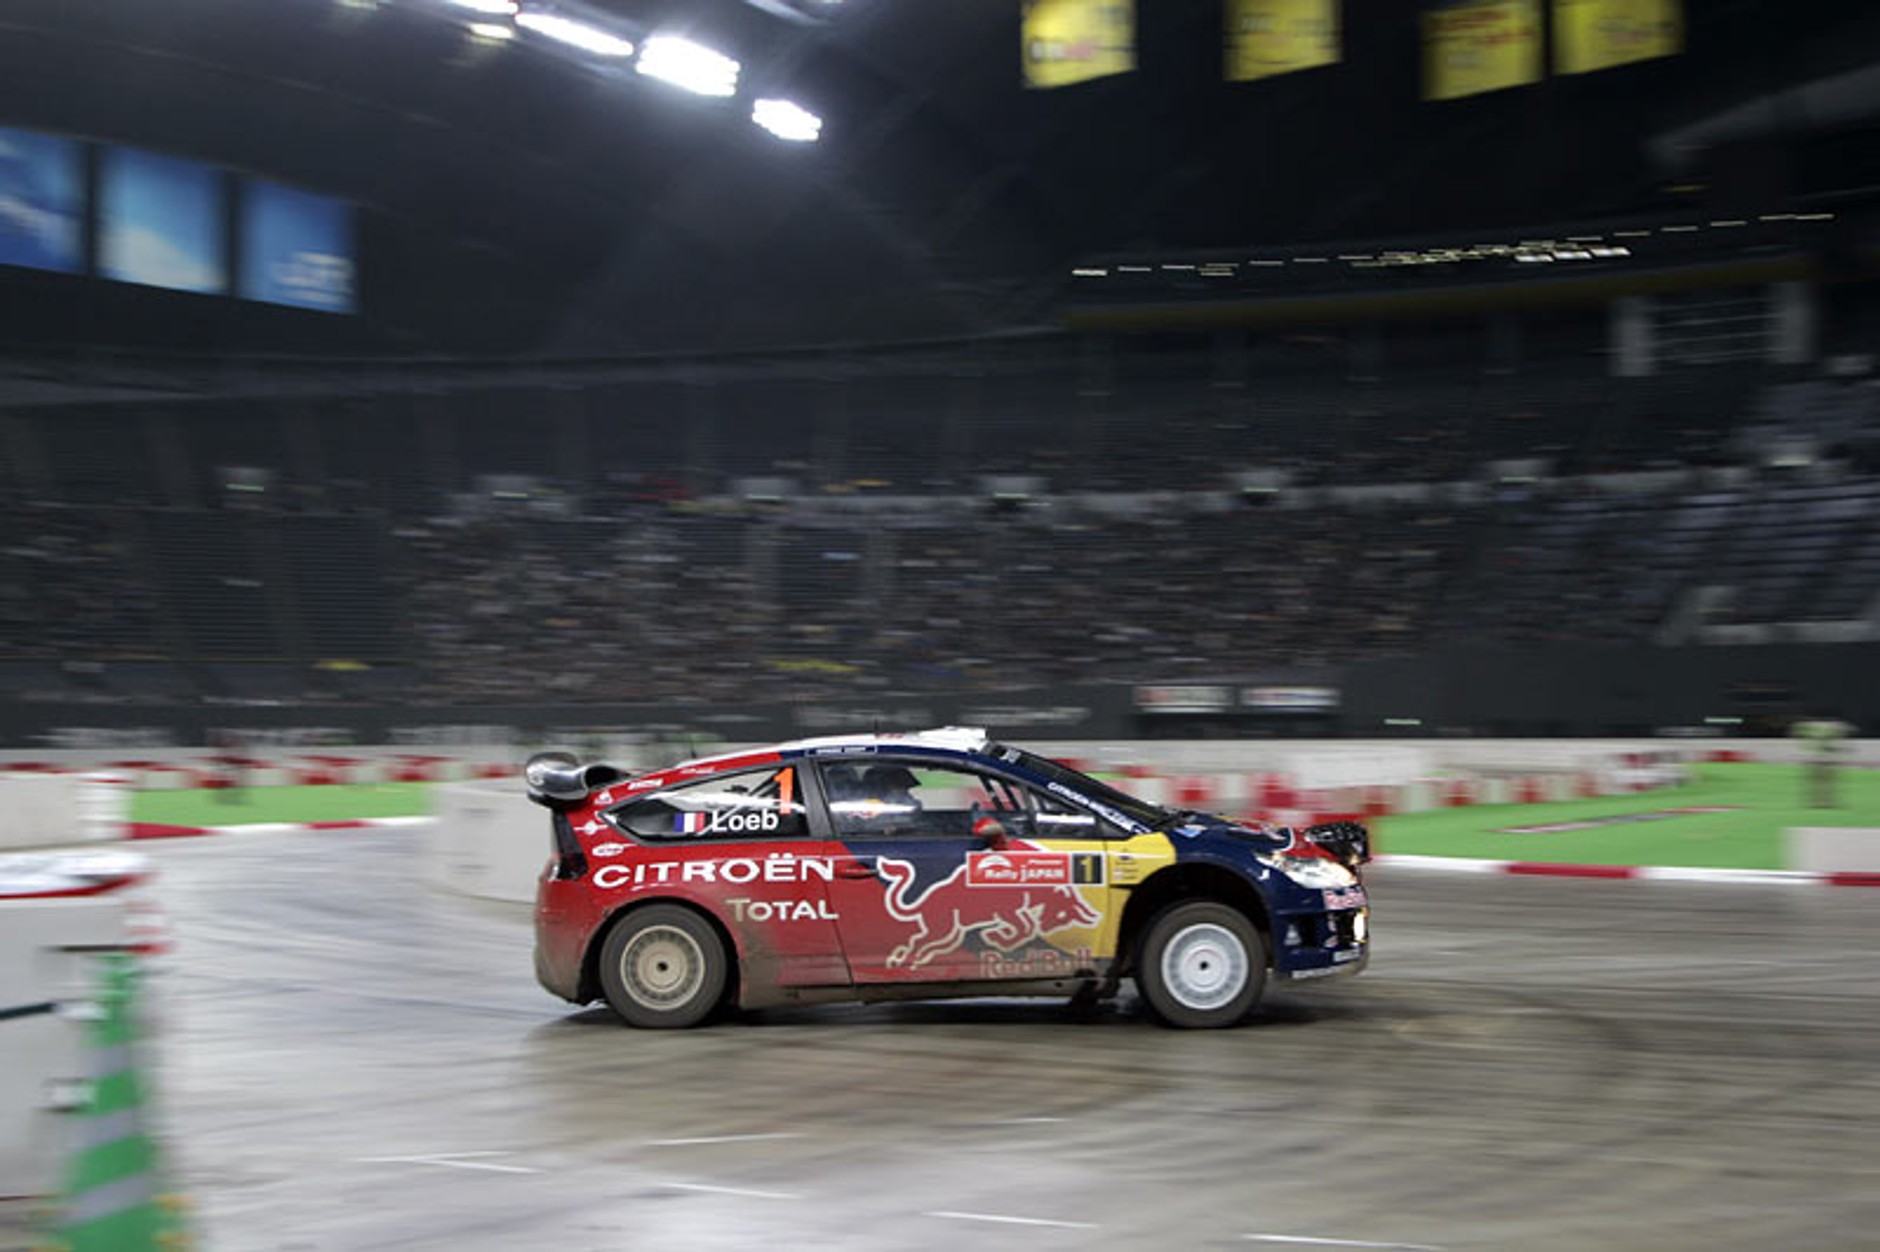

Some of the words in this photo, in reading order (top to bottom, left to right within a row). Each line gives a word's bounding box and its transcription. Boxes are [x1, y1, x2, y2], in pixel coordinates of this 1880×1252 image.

[774, 767, 793, 814] 1
[712, 808, 779, 833] Loeb
[592, 853, 834, 889] CITROËN
[1080, 855, 1094, 882] 1
